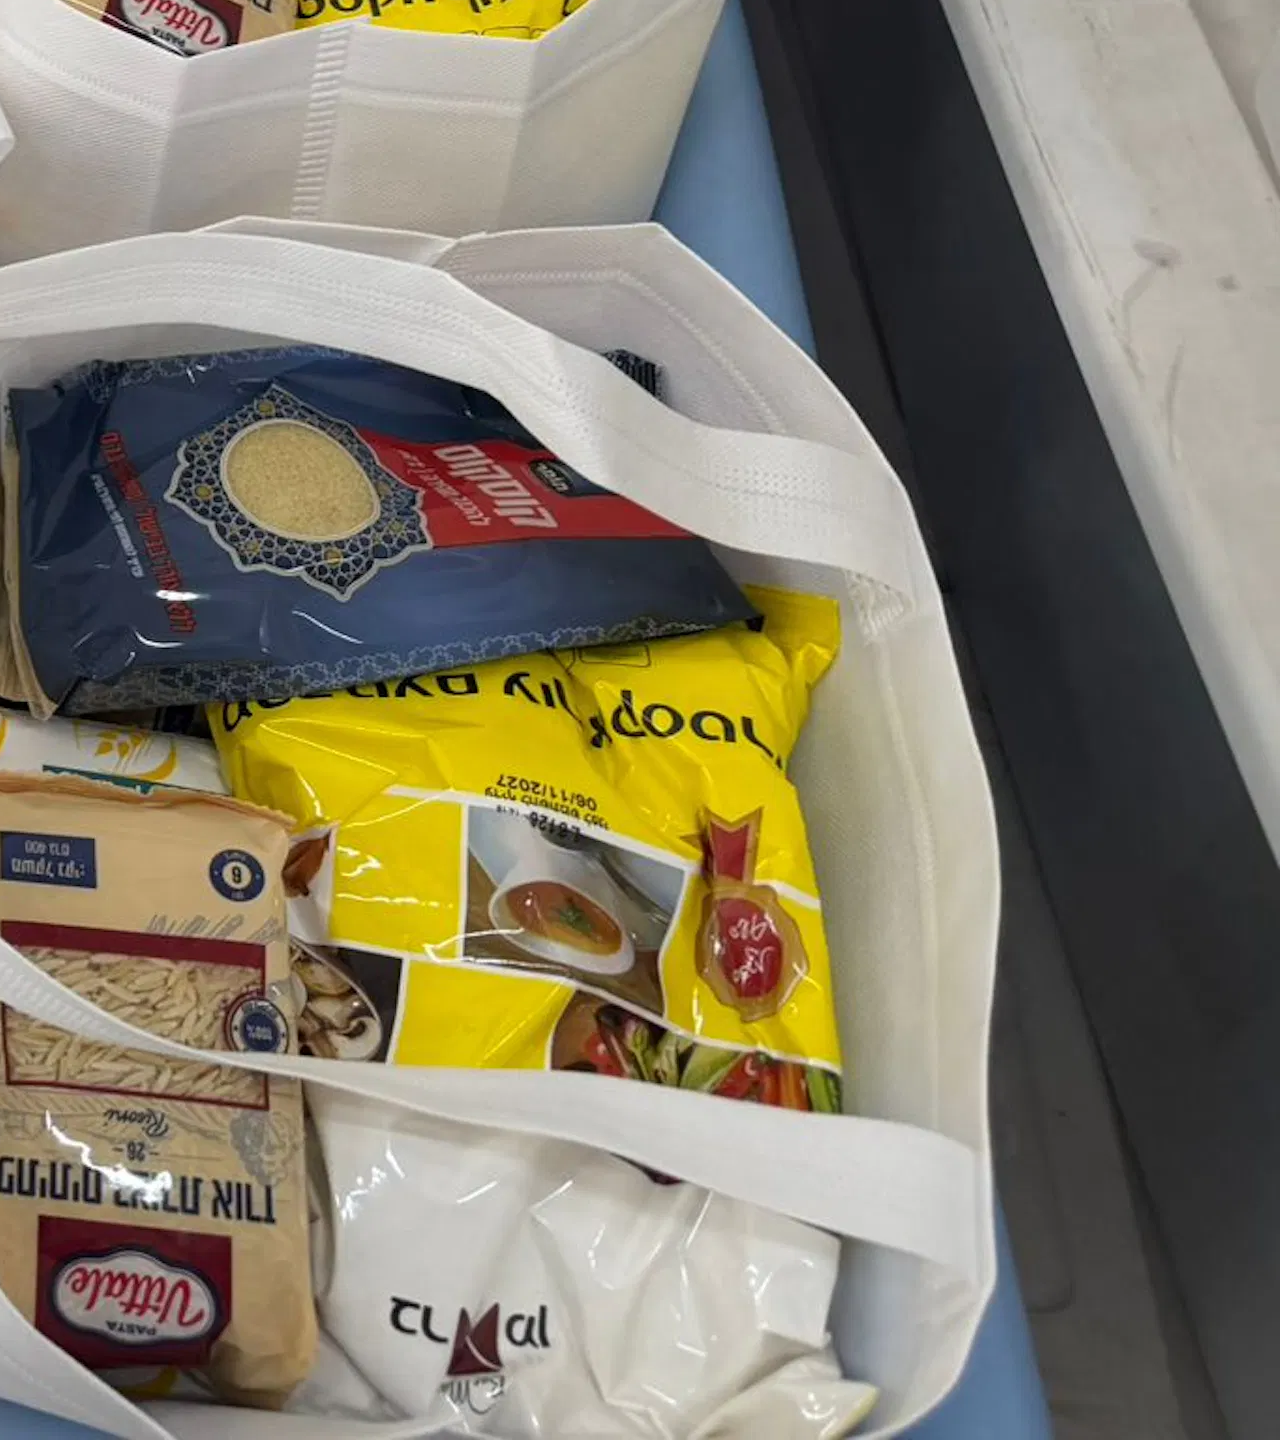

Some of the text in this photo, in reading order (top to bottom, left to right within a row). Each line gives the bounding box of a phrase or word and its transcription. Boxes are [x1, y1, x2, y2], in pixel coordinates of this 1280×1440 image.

[432, 444, 558, 528] קוסקוס
[495, 774, 598, 814] 06/11/2027
[11, 858, 54, 878] משקל
[126, 1142, 146, 1162] 26
[211, 1179, 277, 1225] אורז
[64, 1266, 206, 1329] Vittale
[105, 1319, 158, 1338] PASTA
